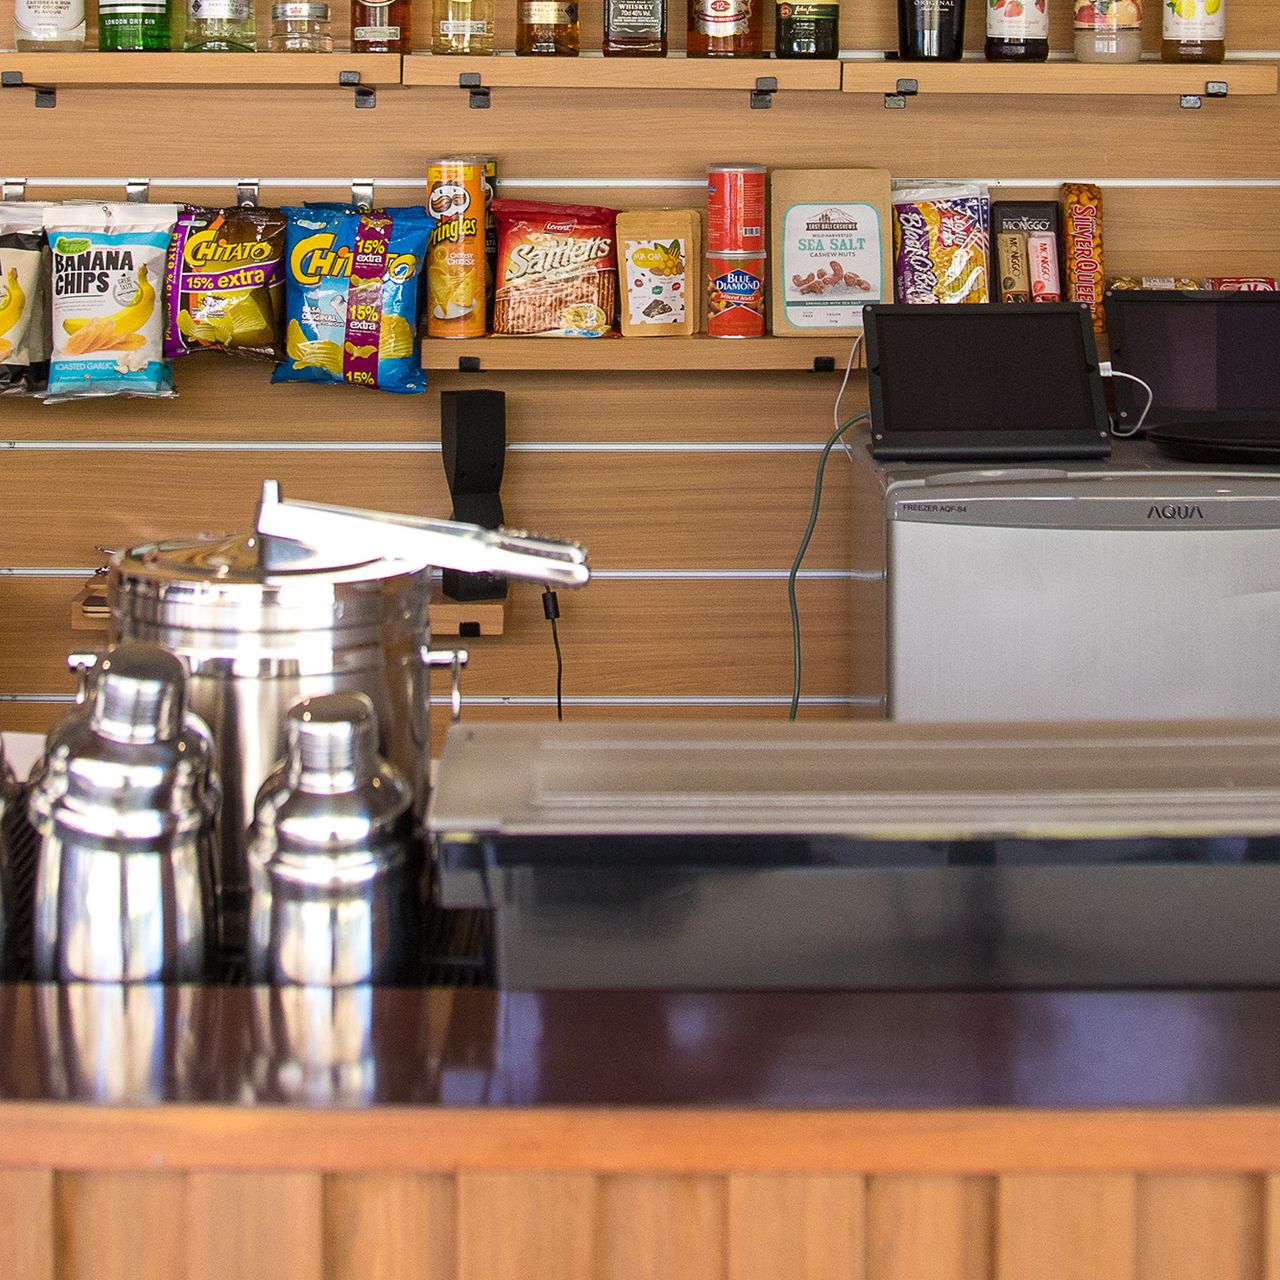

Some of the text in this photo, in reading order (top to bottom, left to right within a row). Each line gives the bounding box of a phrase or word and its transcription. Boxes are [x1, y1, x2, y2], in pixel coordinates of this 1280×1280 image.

[716, 2, 725, 10] 12
[547, 223, 571, 231] Lorenz
[1002, 221, 1050, 230] MONGGO
[357, 240, 385, 254] 15%
[798, 237, 866, 251] SEA SALT
[55, 251, 134, 275] BANANA
[356, 254, 382, 263] extra
[1009, 237, 1020, 277] MONGGO
[1040, 242, 1051, 281] MONGGO
[55, 272, 110, 296] CHIPS
[186, 269, 265, 289] 15% extra
[727, 273, 750, 283] BLUE
[716, 280, 760, 291] DIAMOND
[349, 305, 379, 321] 15%
[350, 321, 376, 330] extra
[346, 371, 375, 384] 15%
[903, 504, 938, 512] FREEZER
[1147, 505, 1204, 520] AQUA
